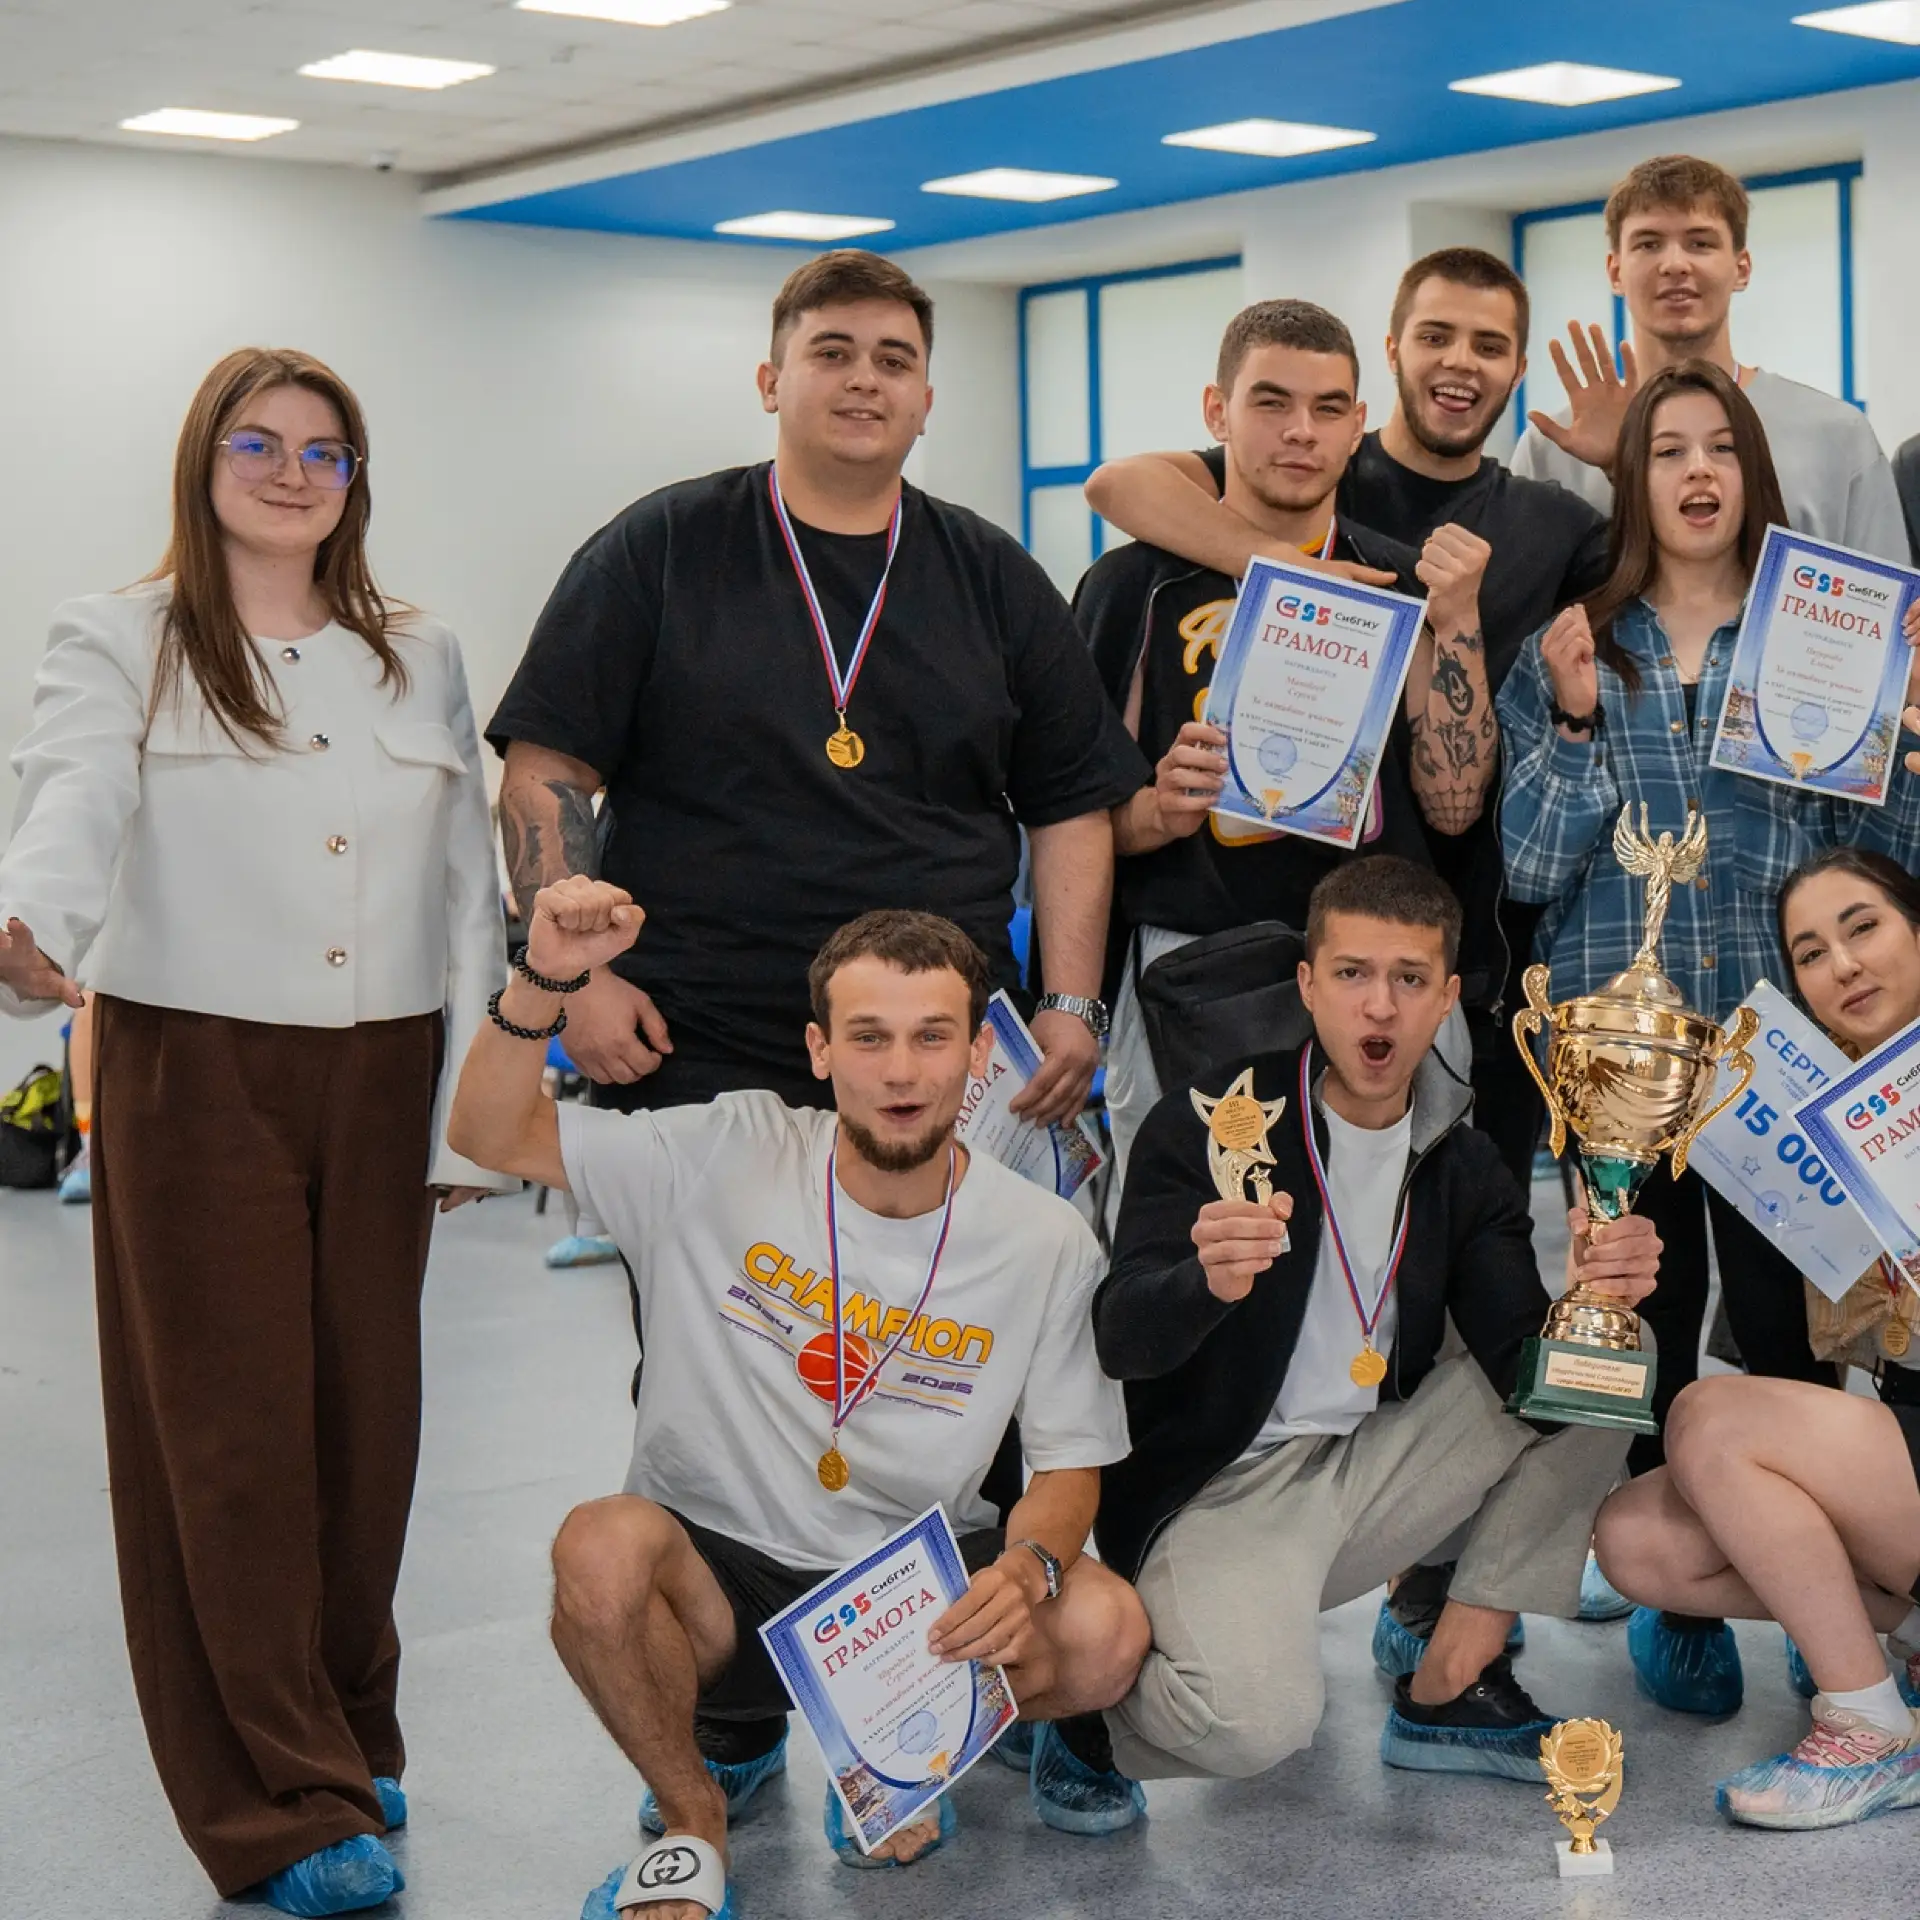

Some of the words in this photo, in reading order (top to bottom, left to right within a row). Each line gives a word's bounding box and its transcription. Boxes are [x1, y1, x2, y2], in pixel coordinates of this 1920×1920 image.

[1847, 582, 1890, 601] СибГИУ
[1334, 611, 1380, 631] СибГИУ
[1781, 593, 1882, 641] ГРАМОТА
[1262, 624, 1369, 670] ГРАМОТА
[1734, 1088, 1779, 1136] 15
[1777, 1133, 1847, 1206] 000
[1860, 1104, 1920, 1162] ГРАМ
[901, 1372, 974, 1395] 2025
[870, 1558, 917, 1596] СибГИУ
[823, 1587, 937, 1678] ГРАМОТА
